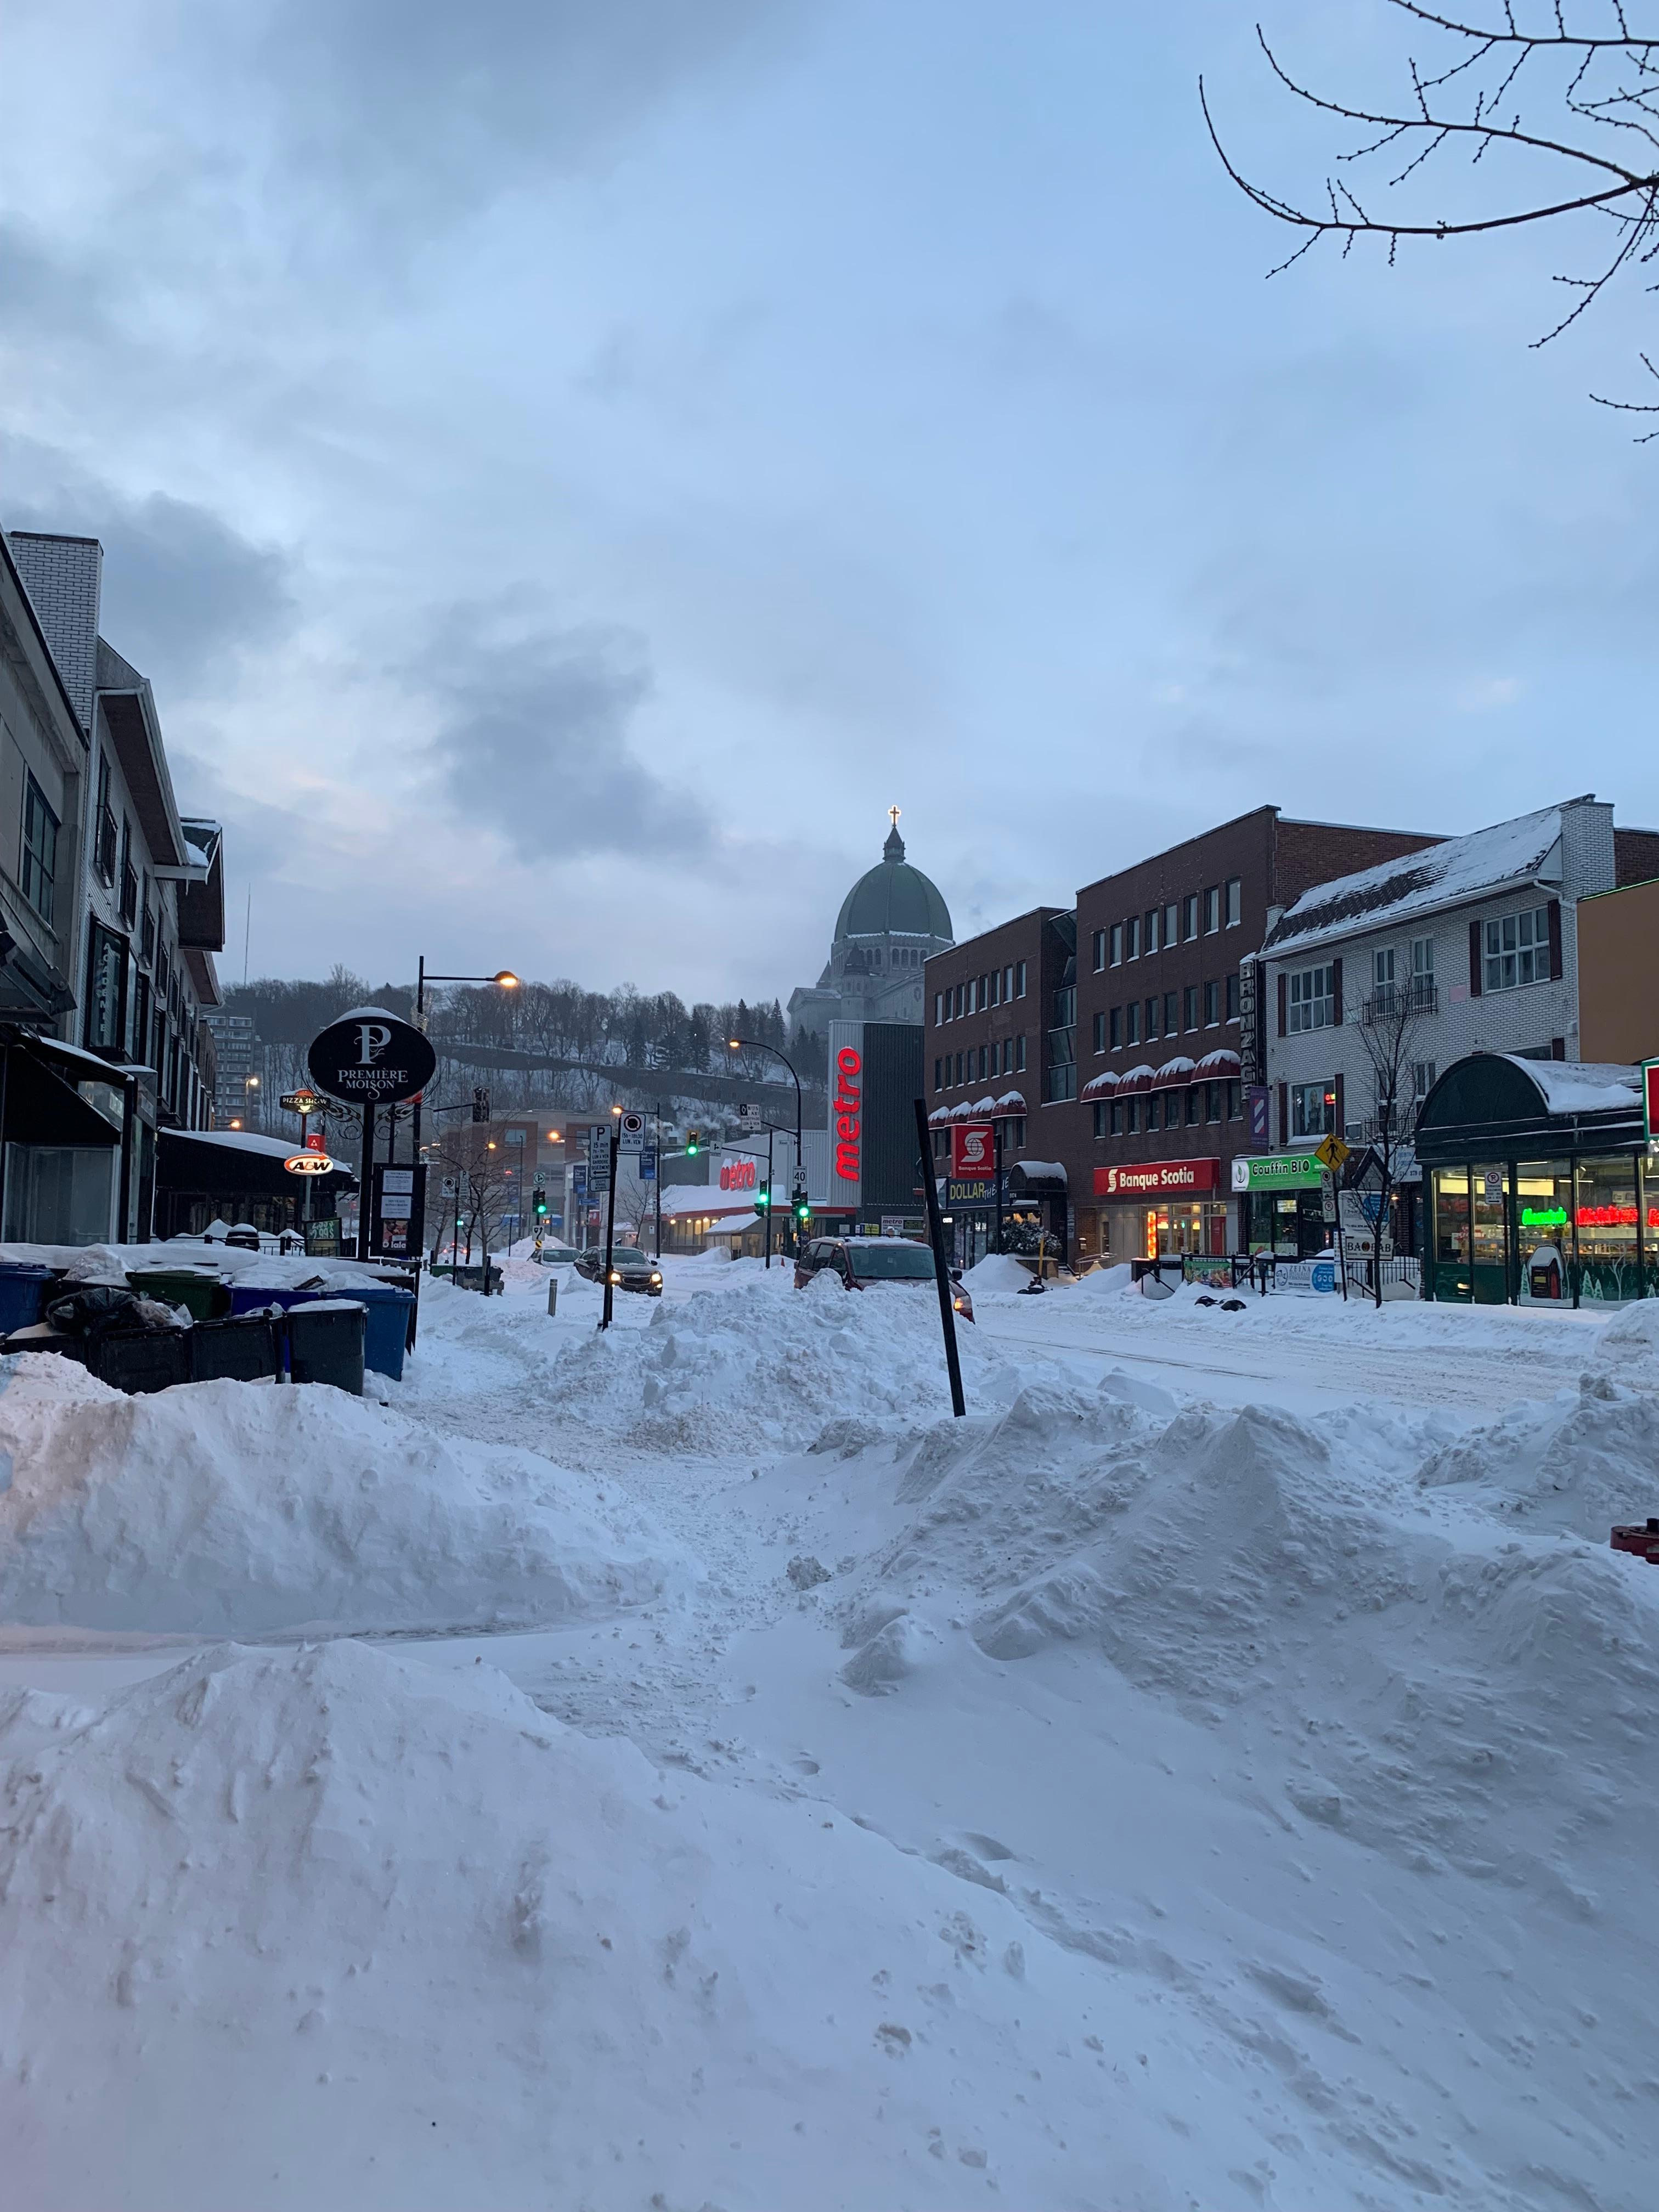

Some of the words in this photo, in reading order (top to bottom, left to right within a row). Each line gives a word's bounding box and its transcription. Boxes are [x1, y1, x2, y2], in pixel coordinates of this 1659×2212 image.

[337, 1067, 408, 1083] PREMIÈRE
[346, 1080, 395, 1100] MOISON
[833, 1047, 861, 1182] metro
[597, 1127, 605, 1141] P
[720, 1159, 755, 1191] metro
[794, 1172, 805, 1181] 40
[1252, 1160, 1288, 1176] Couffin
[1291, 1159, 1310, 1174] BIO
[1120, 1173, 1159, 1190] Banque
[1161, 1166, 1194, 1185] Scotia
